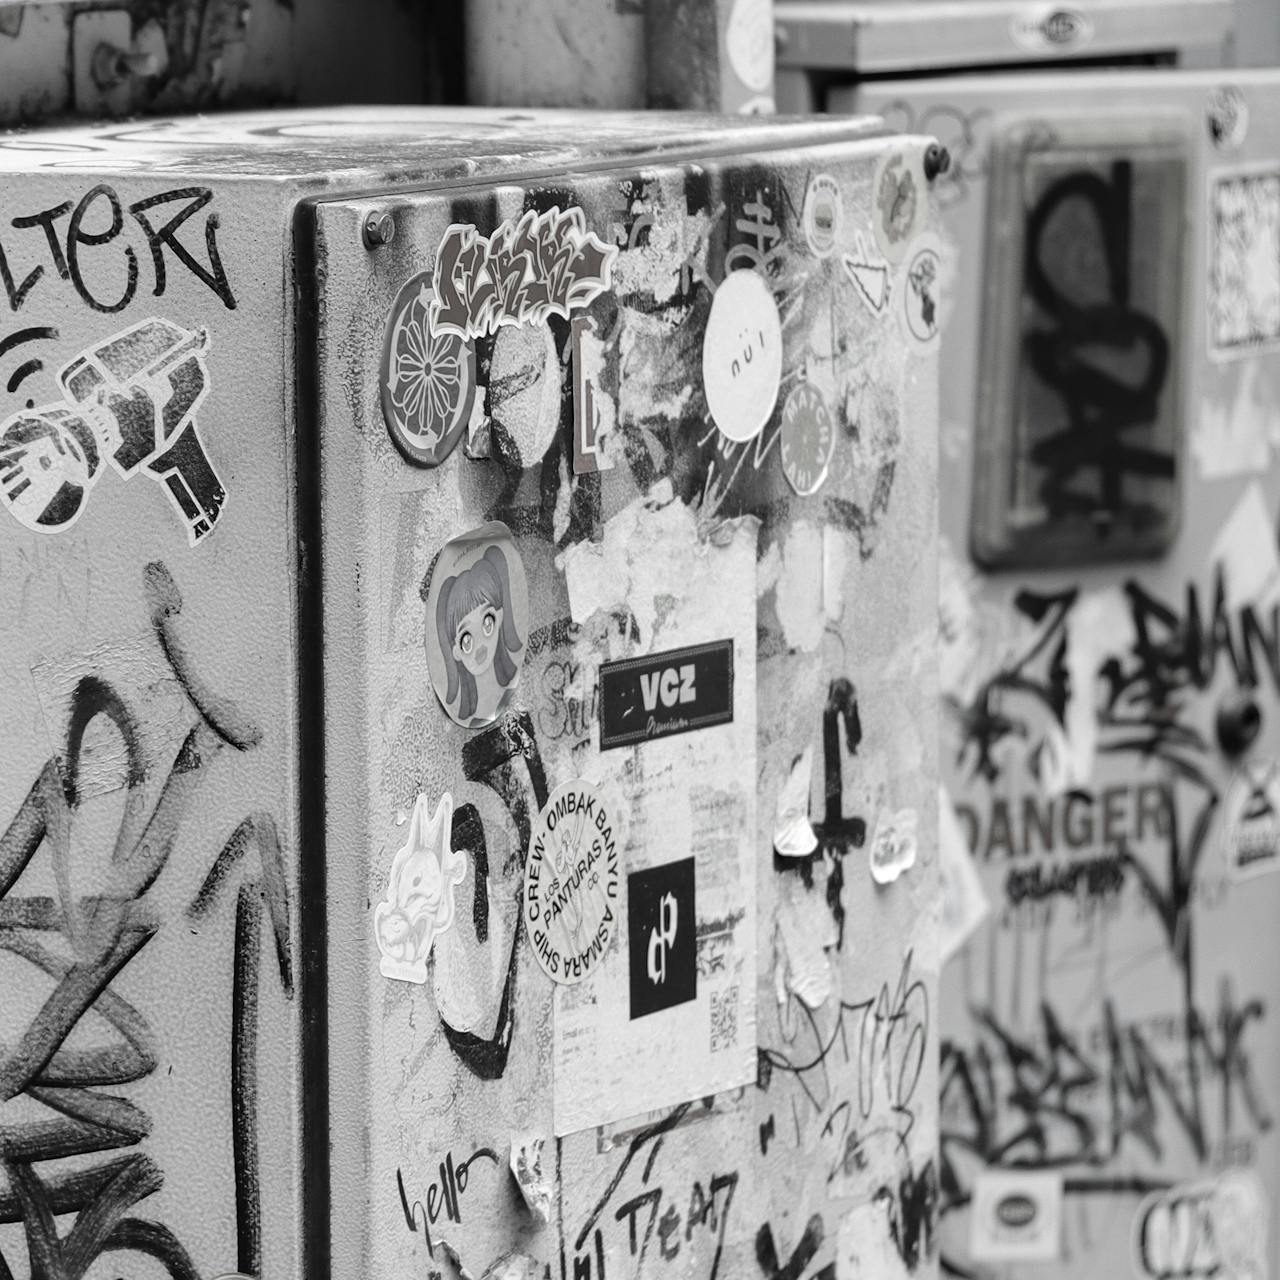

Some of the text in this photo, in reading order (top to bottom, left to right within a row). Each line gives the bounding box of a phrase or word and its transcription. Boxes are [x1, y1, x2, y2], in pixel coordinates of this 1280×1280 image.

[639, 663, 697, 712] VCZ
[546, 791, 597, 832] OMBAK
[956, 784, 1168, 860] DANGER
[543, 839, 603, 930] PANTURAS
[545, 878, 560, 903] LOS
[595, 808, 619, 899] BANYU
[532, 929, 560, 974] SHIP
[563, 903, 614, 979] ASMARA
[397, 1147, 500, 1259] hello
